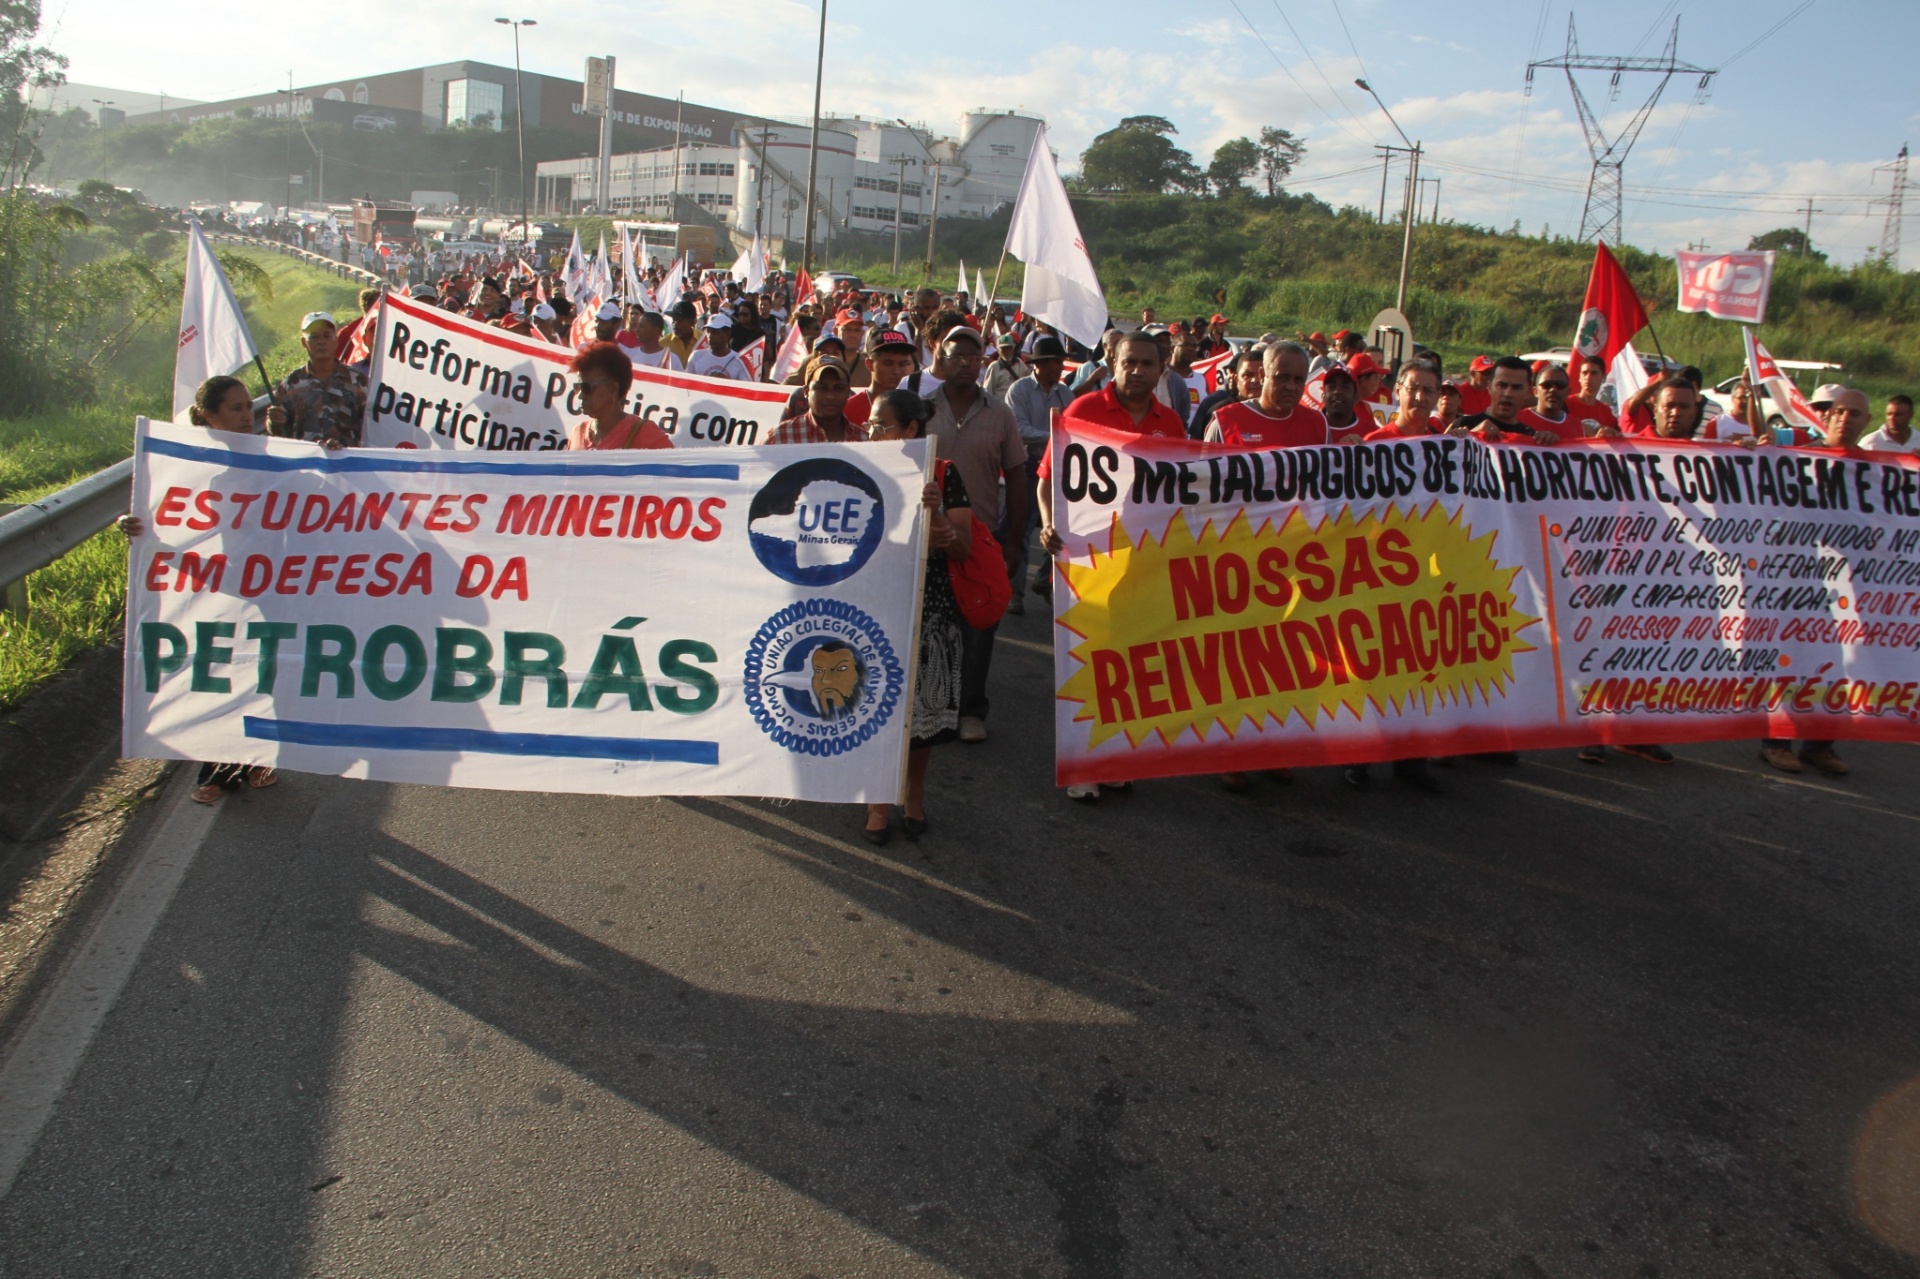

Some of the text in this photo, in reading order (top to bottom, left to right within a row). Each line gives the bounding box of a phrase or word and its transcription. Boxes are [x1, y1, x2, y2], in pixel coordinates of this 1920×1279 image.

[626, 112, 641, 125] DE
[388, 321, 532, 405] Reforma
[689, 412, 759, 446] com
[1061, 442, 1119, 505] OS
[1421, 440, 1458, 495] DE
[1463, 438, 1501, 500] BELO
[1679, 456, 1849, 511] CONTAGEM
[1855, 462, 1875, 514] E
[155, 486, 727, 542] ESTUDANTES MINEIROS
[798, 498, 862, 533] UEE
[1563, 511, 1657, 546] PUNIÇÃO
[1662, 516, 1692, 544] DE
[1695, 517, 1762, 544] TODOS
[1763, 518, 1885, 550] ENVOLVIDOS
[798, 533, 860, 545] Minas Gerais
[145, 551, 530, 601] EM DEFESA DA
[1168, 527, 1420, 621] NOSSAS
[1561, 549, 1644, 578] CONTRA
[1645, 549, 1662, 576] O
[1661, 550, 1685, 576] PL
[1757, 553, 1848, 581] REFORMA
[1848, 554, 1920, 586] POLÍTIC
[1568, 583, 1628, 609] COM
[1632, 583, 1739, 610] EMPREGO
[1738, 585, 1753, 610] E
[795, 618, 864, 645] COLEGIAL
[1573, 616, 1592, 642] O
[1601, 615, 1681, 641] ACESSO
[1682, 615, 1713, 641] AO
[1712, 615, 1779, 642] SEGURO
[140, 616, 719, 716] PETROBRÁS
[860, 645, 876, 662] DE
[1578, 647, 1599, 672] E
[1603, 641, 1699, 672] AUXÍLIO
[764, 686, 795, 727] UCMG
[858, 665, 883, 717] MINAS
[1579, 676, 1797, 713] IMPEACHMENT
[1793, 662, 1834, 713] É
[806, 715, 857, 737] GERAIS
